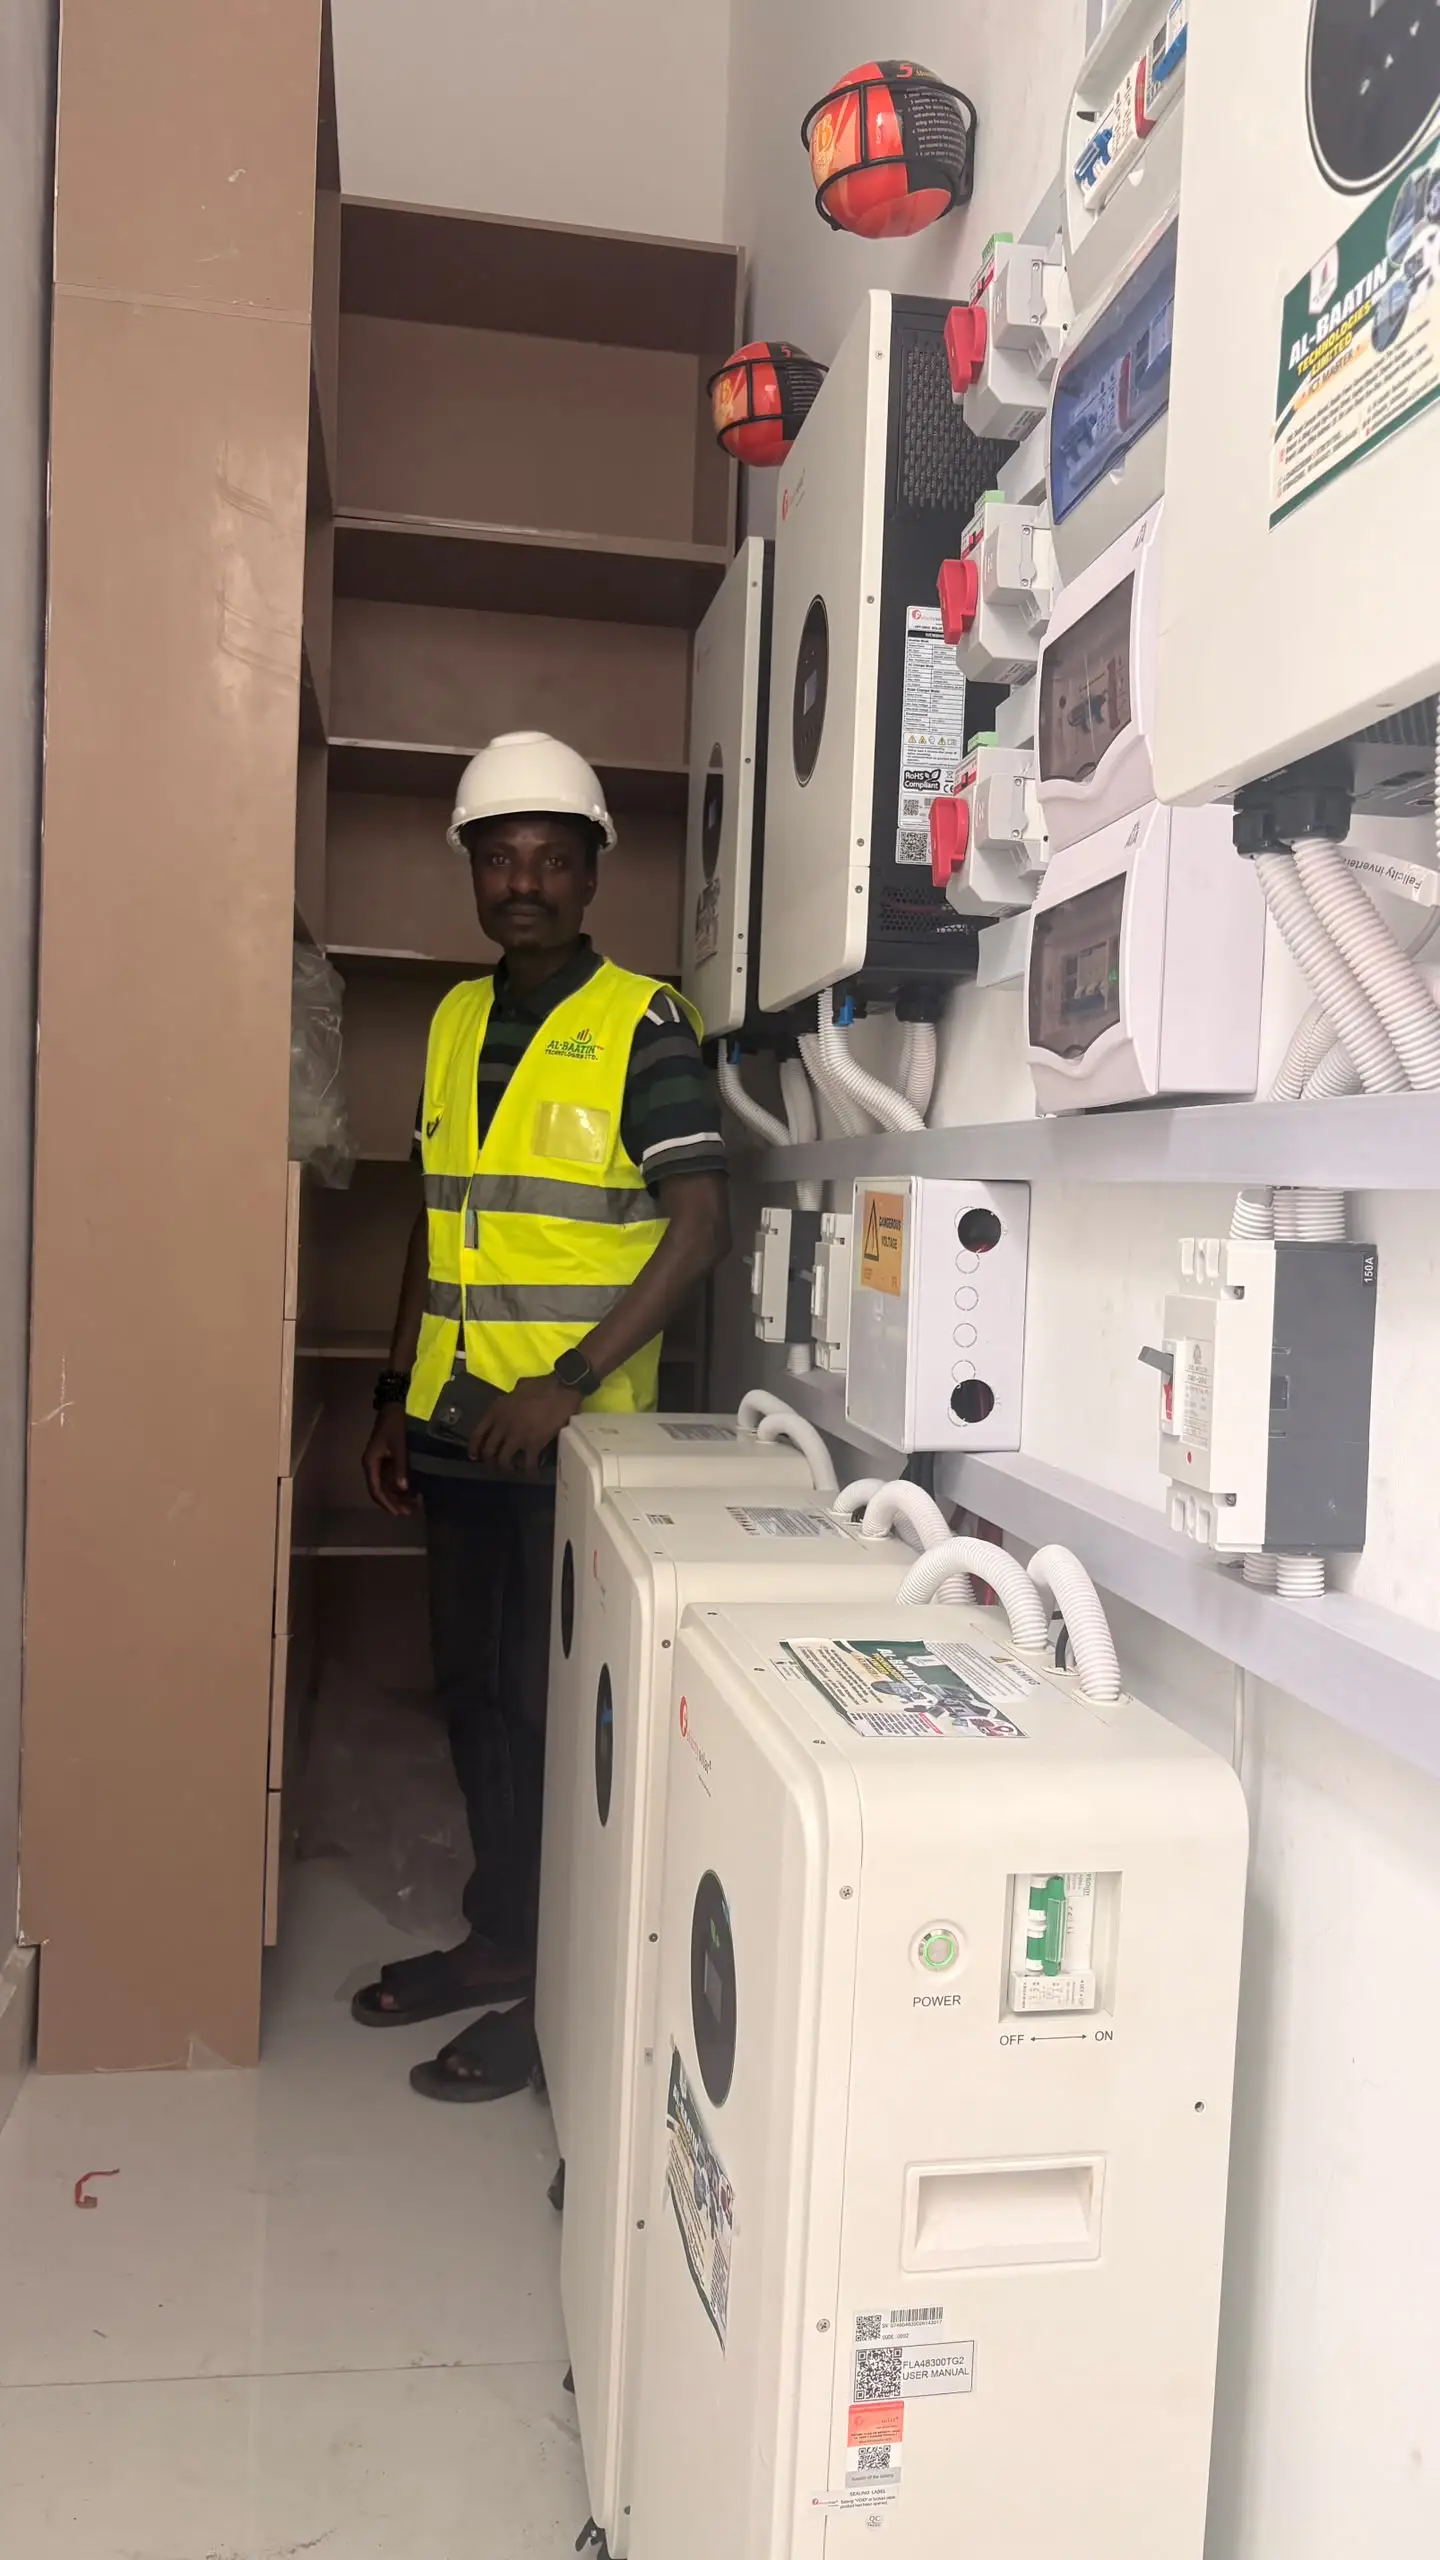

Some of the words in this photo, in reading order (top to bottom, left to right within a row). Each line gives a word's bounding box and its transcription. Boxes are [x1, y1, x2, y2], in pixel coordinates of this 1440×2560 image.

[896, 63, 913, 79] 5
[1288, 256, 1388, 371] AL-BAATIN
[1297, 299, 1373, 376] TECHNOLOGIES
[905, 772, 925, 781] RoHS
[904, 780, 939, 791] Compliant
[1364, 1256, 1374, 1283] 150A
[1004, 1662, 1041, 1686] WARNING
[913, 1995, 962, 2008] POWER
[999, 2034, 1025, 2047] OFF
[1094, 2030, 1114, 2042] ON
[902, 2356, 965, 2370] FLA48300TG2
[902, 2370, 929, 2381] USER
[930, 2366, 970, 2379] MANUAL
